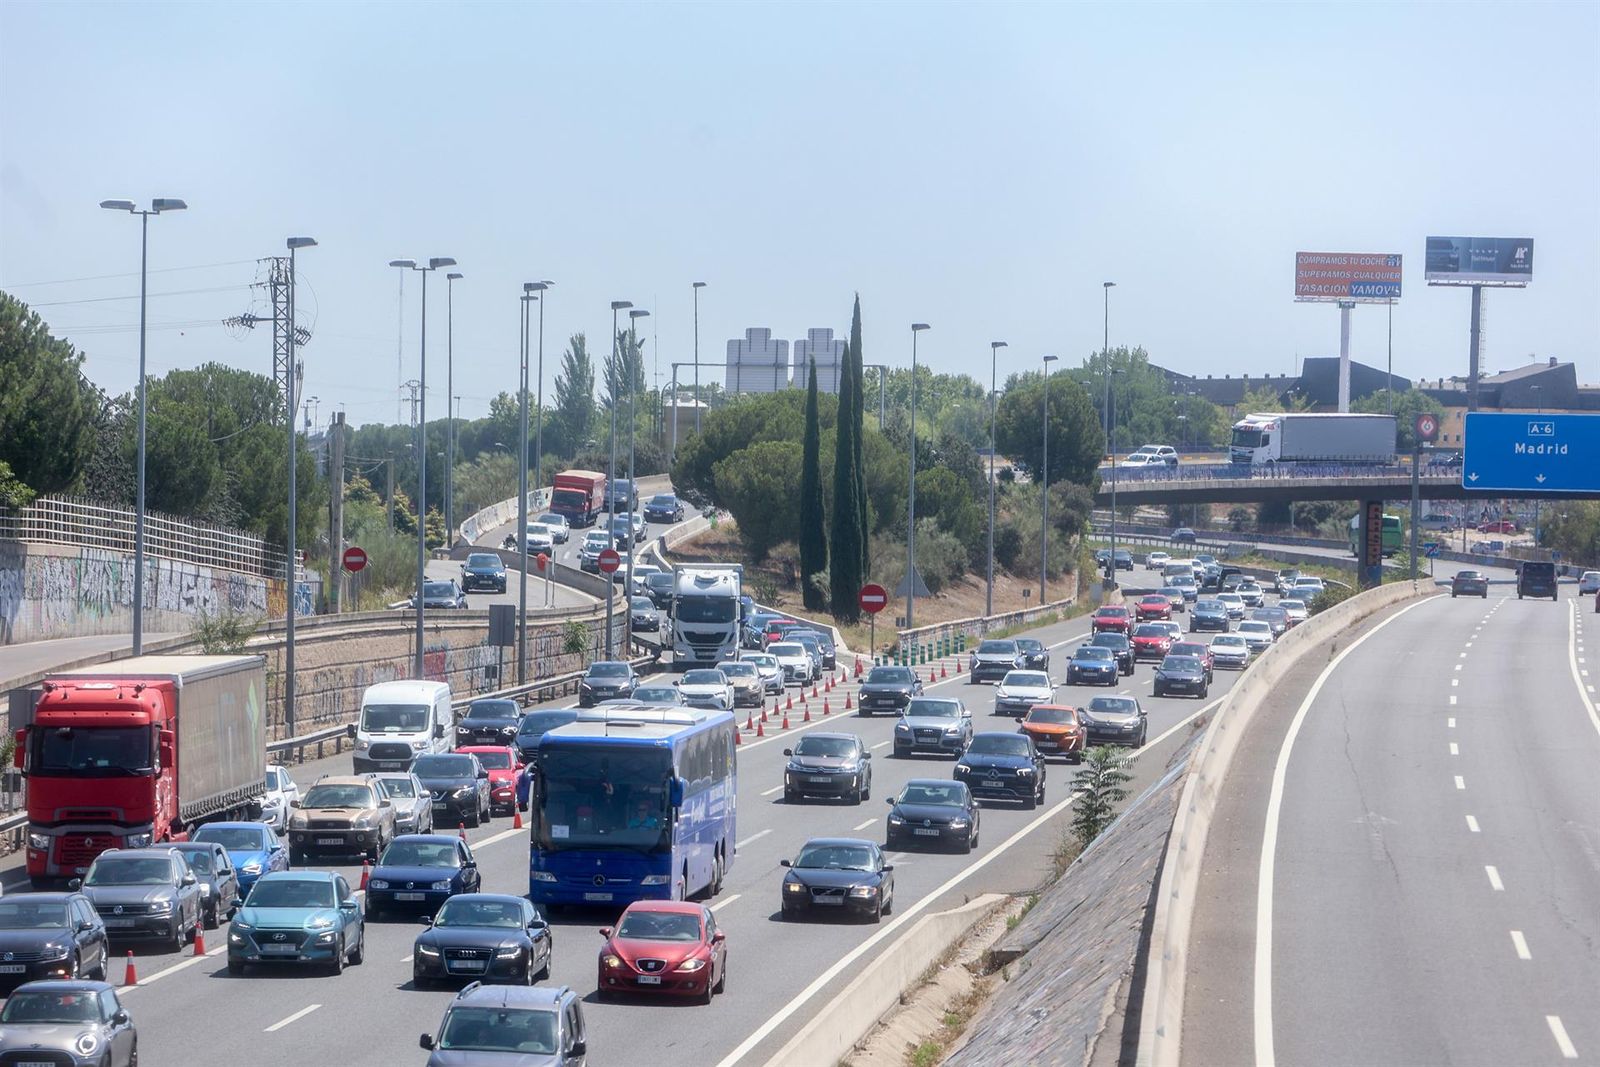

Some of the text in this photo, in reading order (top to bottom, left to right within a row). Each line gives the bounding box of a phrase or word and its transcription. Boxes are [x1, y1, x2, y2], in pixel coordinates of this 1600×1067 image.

[1298, 255, 1385, 266] COMPRAMOS TU COCHE
[1298, 270, 1400, 279] SUPERAMOS CUALQUIER
[1514, 442, 1568, 455] Madrid
